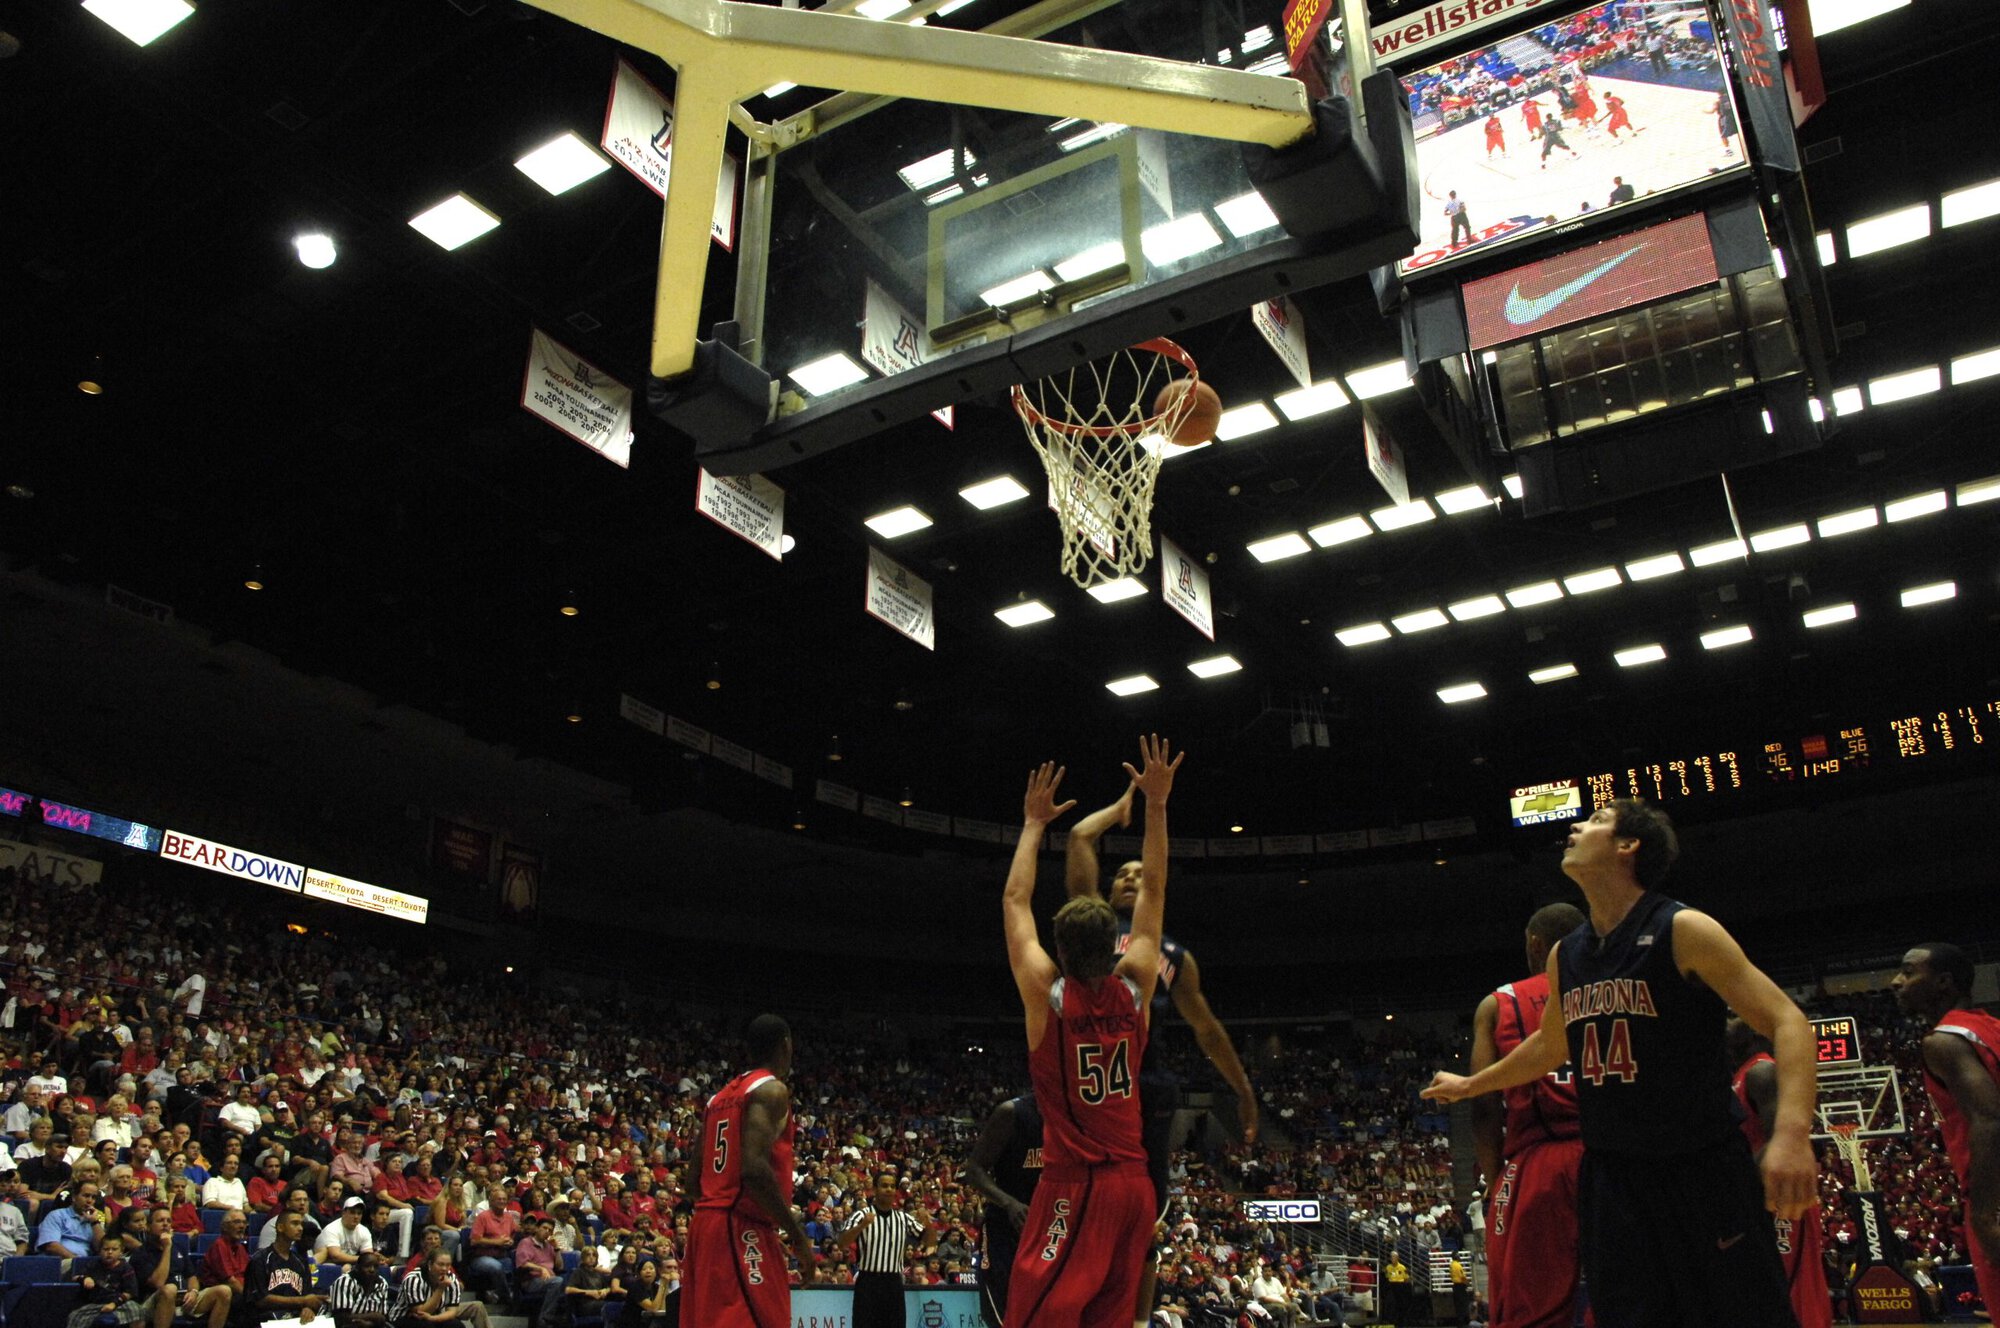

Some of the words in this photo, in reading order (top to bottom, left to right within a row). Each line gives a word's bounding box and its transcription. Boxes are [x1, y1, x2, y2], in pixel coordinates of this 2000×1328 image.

[1288, 0, 1318, 57] FARG
[1373, 0, 1541, 55] wellsfa
[1890, 716, 1921, 730] PLYR
[1898, 726, 1920, 738] PTS
[1840, 728, 1864, 740] BLUE
[1764, 742, 1782, 753] RED
[1848, 738, 1867, 754] 56
[1586, 772, 1614, 786] PLYR
[1669, 760, 1686, 771] 20
[1694, 756, 1711, 766] 42
[1719, 752, 1736, 762] 50
[1768, 752, 1786, 767] 46
[1804, 758, 1840, 778] 11:49
[1515, 780, 1572, 798] O'RIELLY
[1592, 782, 1612, 793] PTS
[1518, 808, 1578, 826] WATSON
[307, 876, 334, 890] DESERT
[336, 884, 364, 898] TOYOTA
[372, 894, 398, 906] DESERT
[400, 901, 426, 913] TOYOTA
[1564, 978, 1659, 1027] ARIZONA
[1582, 1018, 1638, 1086] 44
[1818, 1039, 1847, 1061] 23
[1077, 1038, 1132, 1105] 54
[713, 1118, 730, 1174] 5
[1494, 1162, 1519, 1236] CATS
[1248, 1204, 1318, 1220] GEICO
[1041, 1198, 1070, 1260] CATS
[1773, 1208, 1795, 1254] ATS
[1860, 1197, 1882, 1260] ARIZONA
[742, 1229, 764, 1285] CATS
[1858, 1288, 1910, 1298] WELLS
[1862, 1300, 1912, 1310] FARGO
